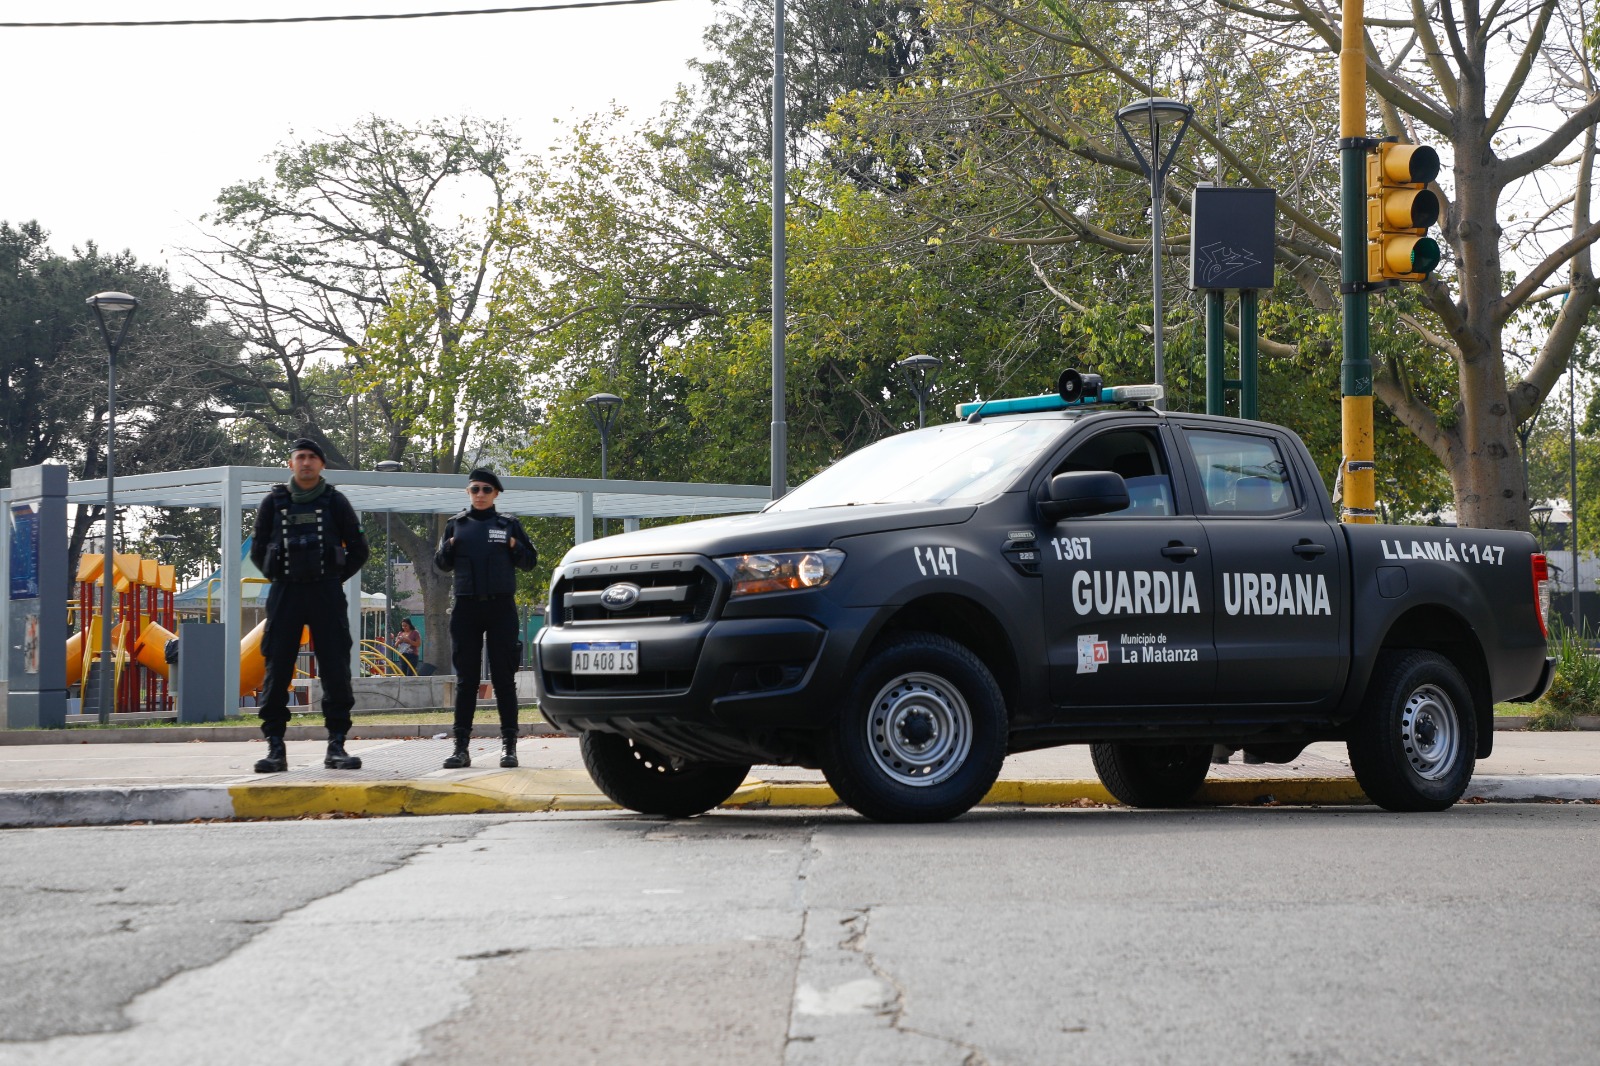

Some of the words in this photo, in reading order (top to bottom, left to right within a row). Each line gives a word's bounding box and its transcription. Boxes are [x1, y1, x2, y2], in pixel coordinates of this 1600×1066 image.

[1051, 537, 1091, 560] 1367
[1380, 538, 1460, 562] LLAMÁ
[1469, 545, 1505, 566] 147
[573, 560, 683, 574] RANGER
[925, 547, 958, 576] 147
[606, 587, 628, 603] Ford
[1072, 570, 1201, 616] GUARDIA
[1223, 572, 1332, 616] URBANA
[1121, 633, 1156, 647] Municipio
[1157, 633, 1167, 644] de
[574, 653, 589, 671] AD
[593, 653, 615, 671] 408
[619, 652, 634, 671] IS
[1121, 646, 1139, 664] La
[1142, 646, 1199, 663] Matanza
